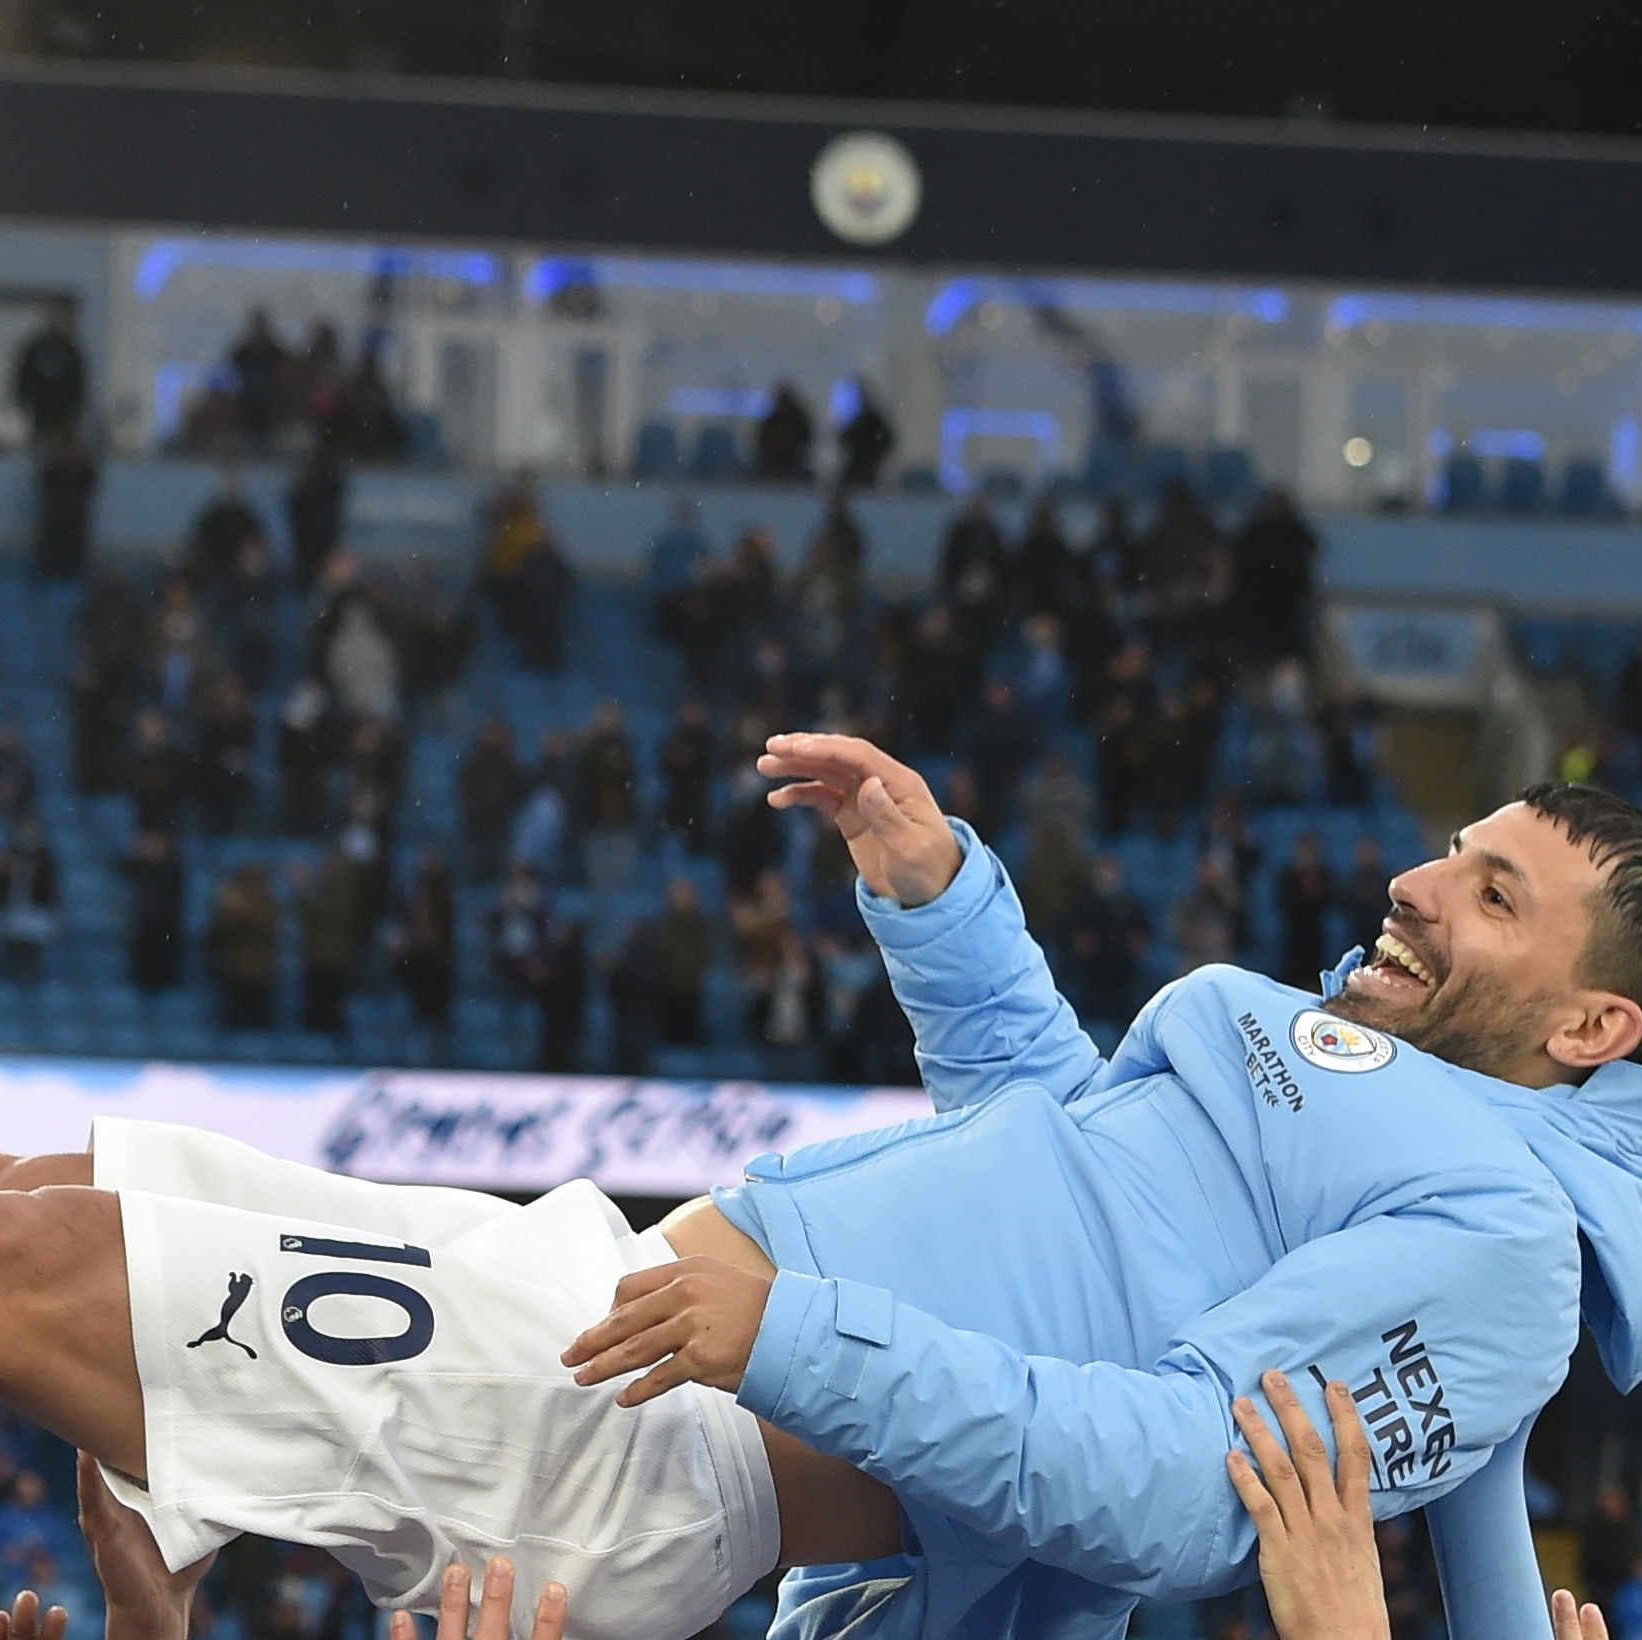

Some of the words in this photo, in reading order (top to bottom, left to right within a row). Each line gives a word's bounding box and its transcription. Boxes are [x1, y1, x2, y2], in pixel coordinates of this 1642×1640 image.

[1237, 1011, 1306, 1113] MARATHON
[1246, 1051, 1271, 1088] BET
[279, 1233, 435, 1368] 10
[1350, 1366, 1416, 1489] TIRE
[1380, 1318, 1457, 1482] NEXEN
